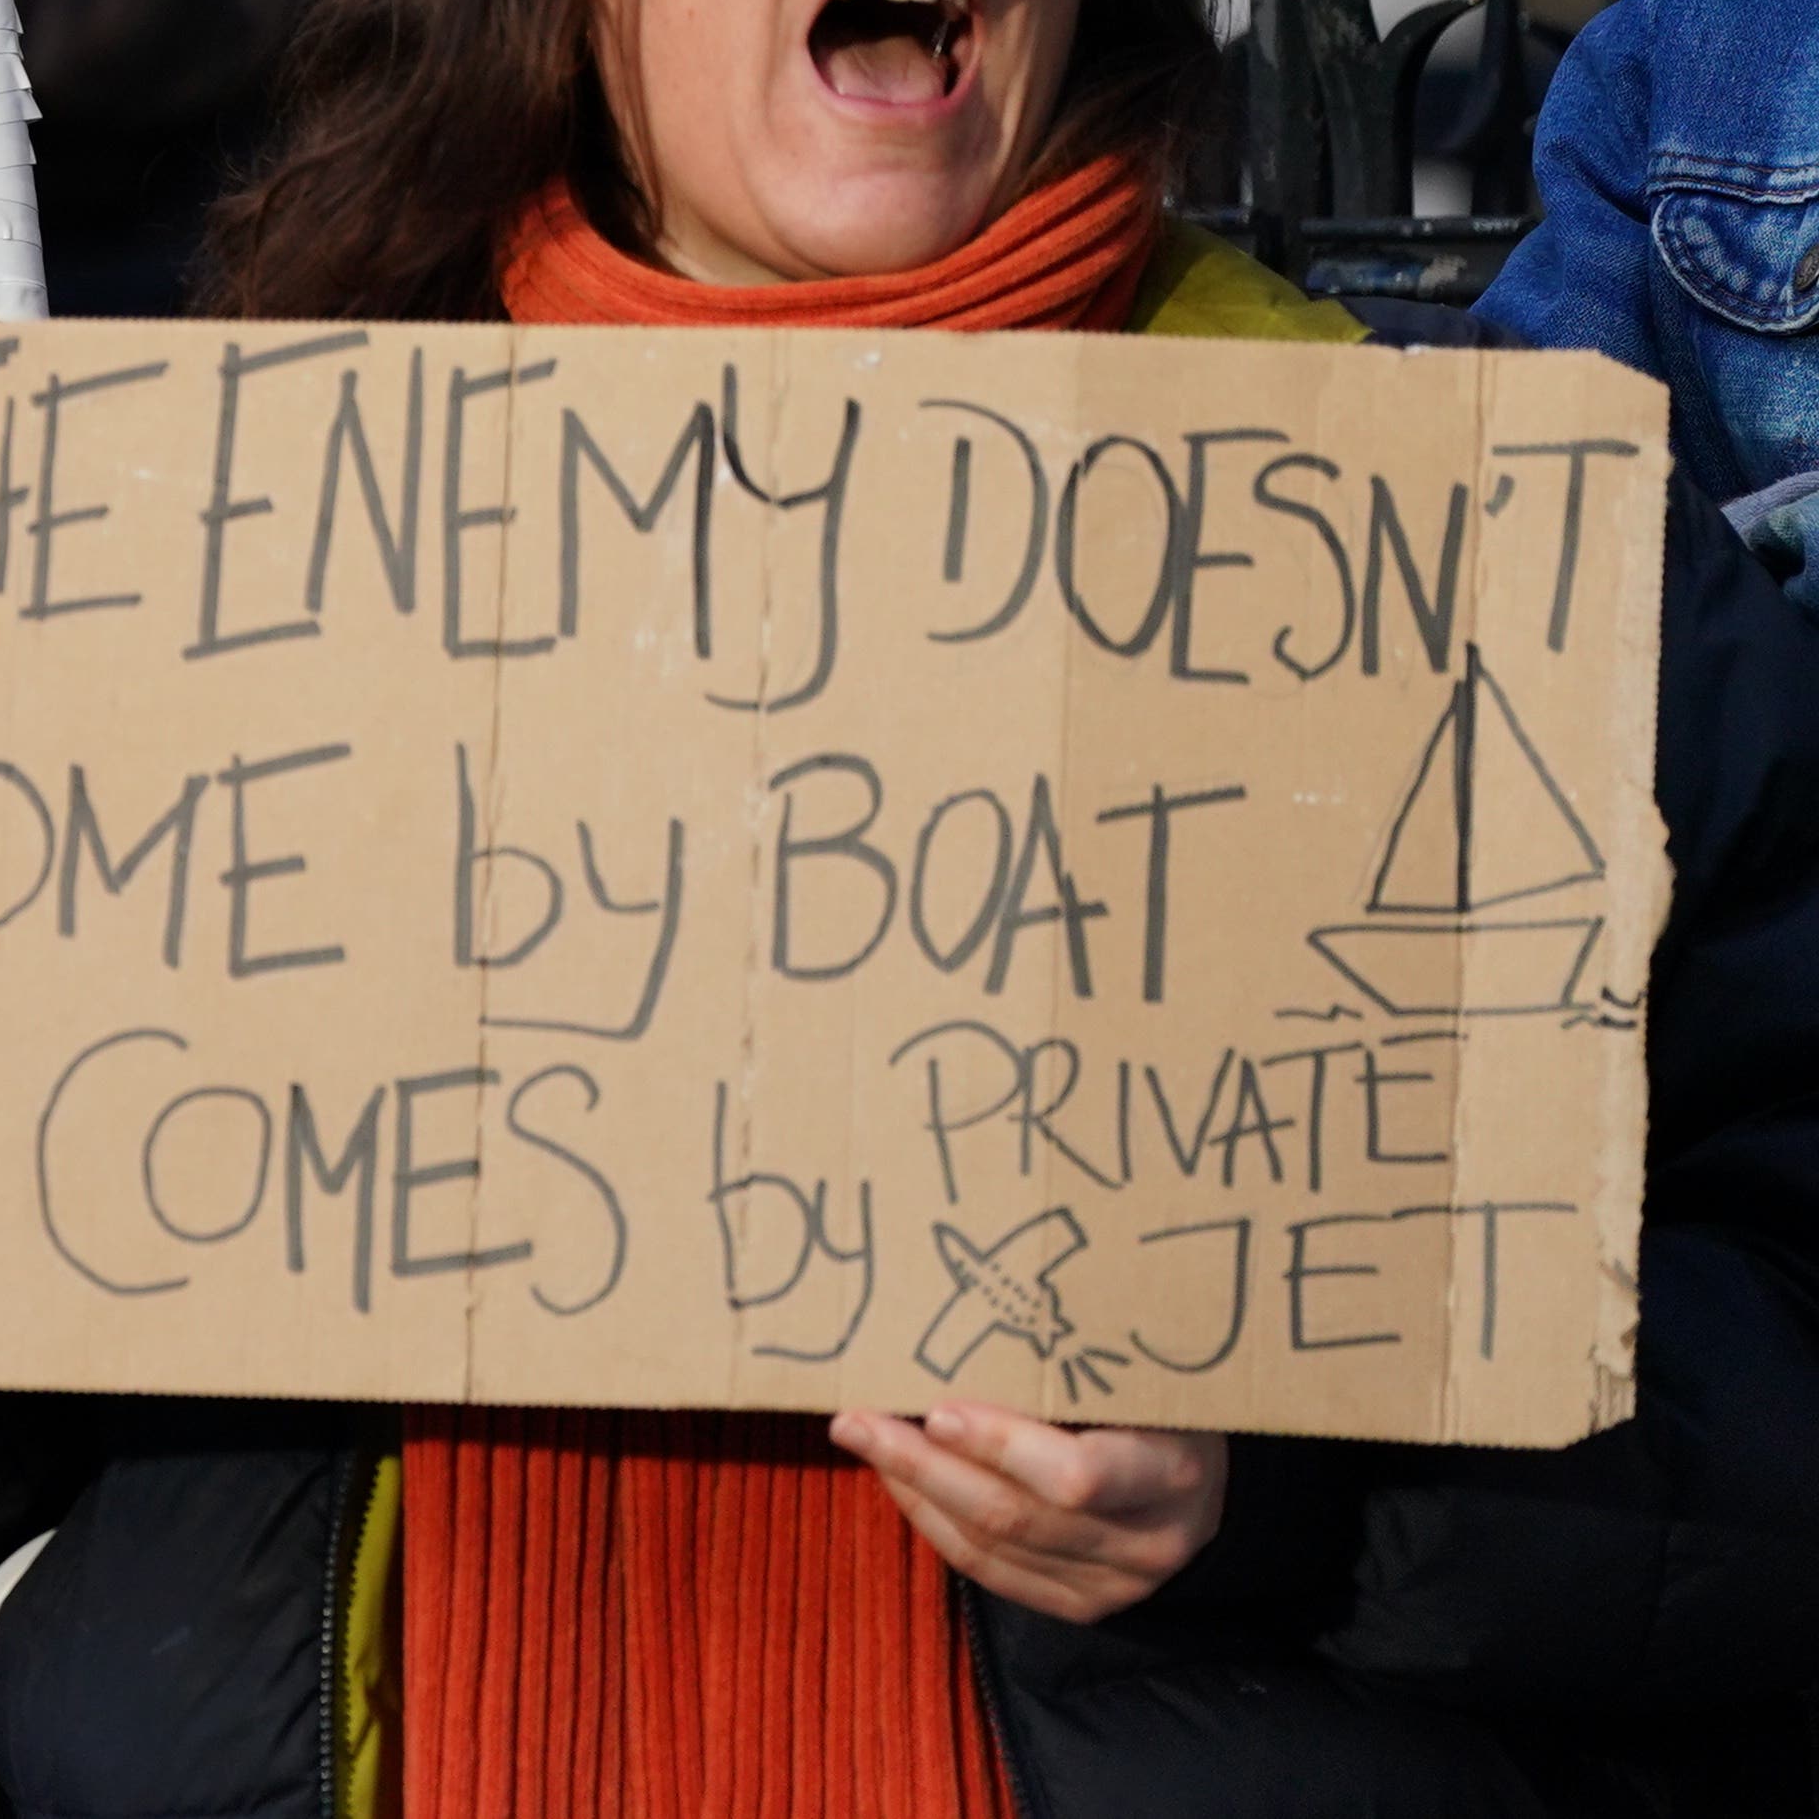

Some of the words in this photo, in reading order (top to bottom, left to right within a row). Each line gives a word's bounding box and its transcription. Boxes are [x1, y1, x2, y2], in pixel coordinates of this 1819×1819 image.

[183, 330, 862, 714] ENEMY
[919, 397, 1642, 685] DOESN'T
[454, 740, 686, 1040] by
[769, 751, 1247, 1004] BOAT
[35, 1027, 629, 1316] COMES
[708, 1079, 875, 1362] by
[889, 1021, 1471, 1204] PRIVATE
[1130, 1199, 1577, 1374] JET
